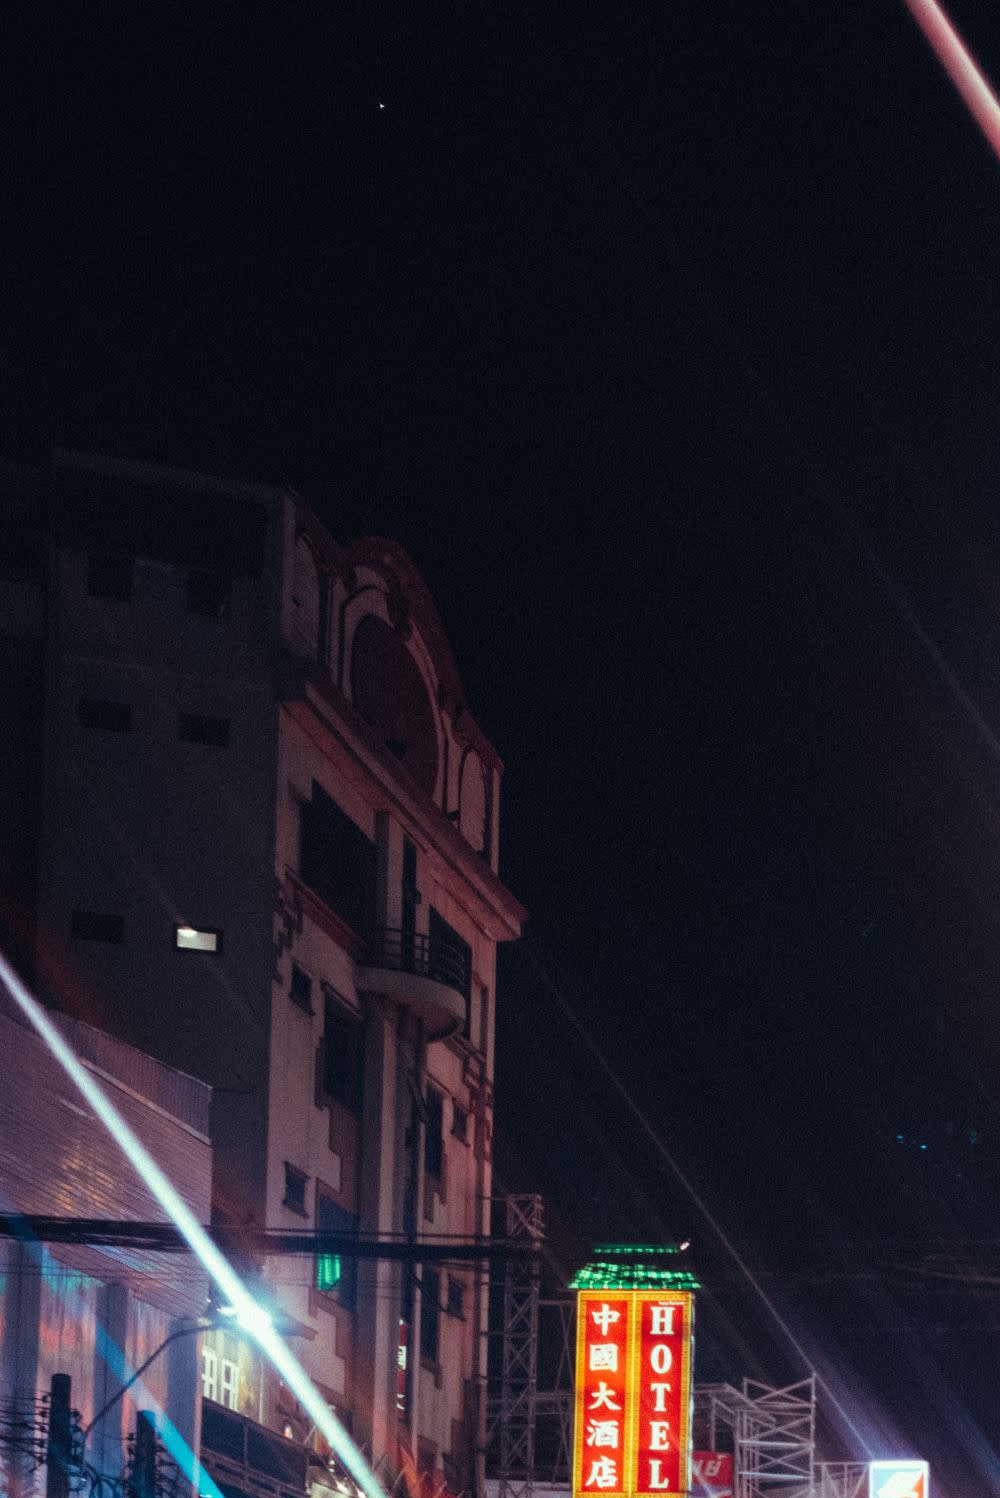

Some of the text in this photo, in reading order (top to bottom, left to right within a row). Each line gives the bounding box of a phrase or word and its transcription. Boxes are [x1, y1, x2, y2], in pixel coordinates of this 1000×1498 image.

[585, 1303, 622, 1489] 中國大酒店
[648, 1306, 675, 1490] HOTEL
